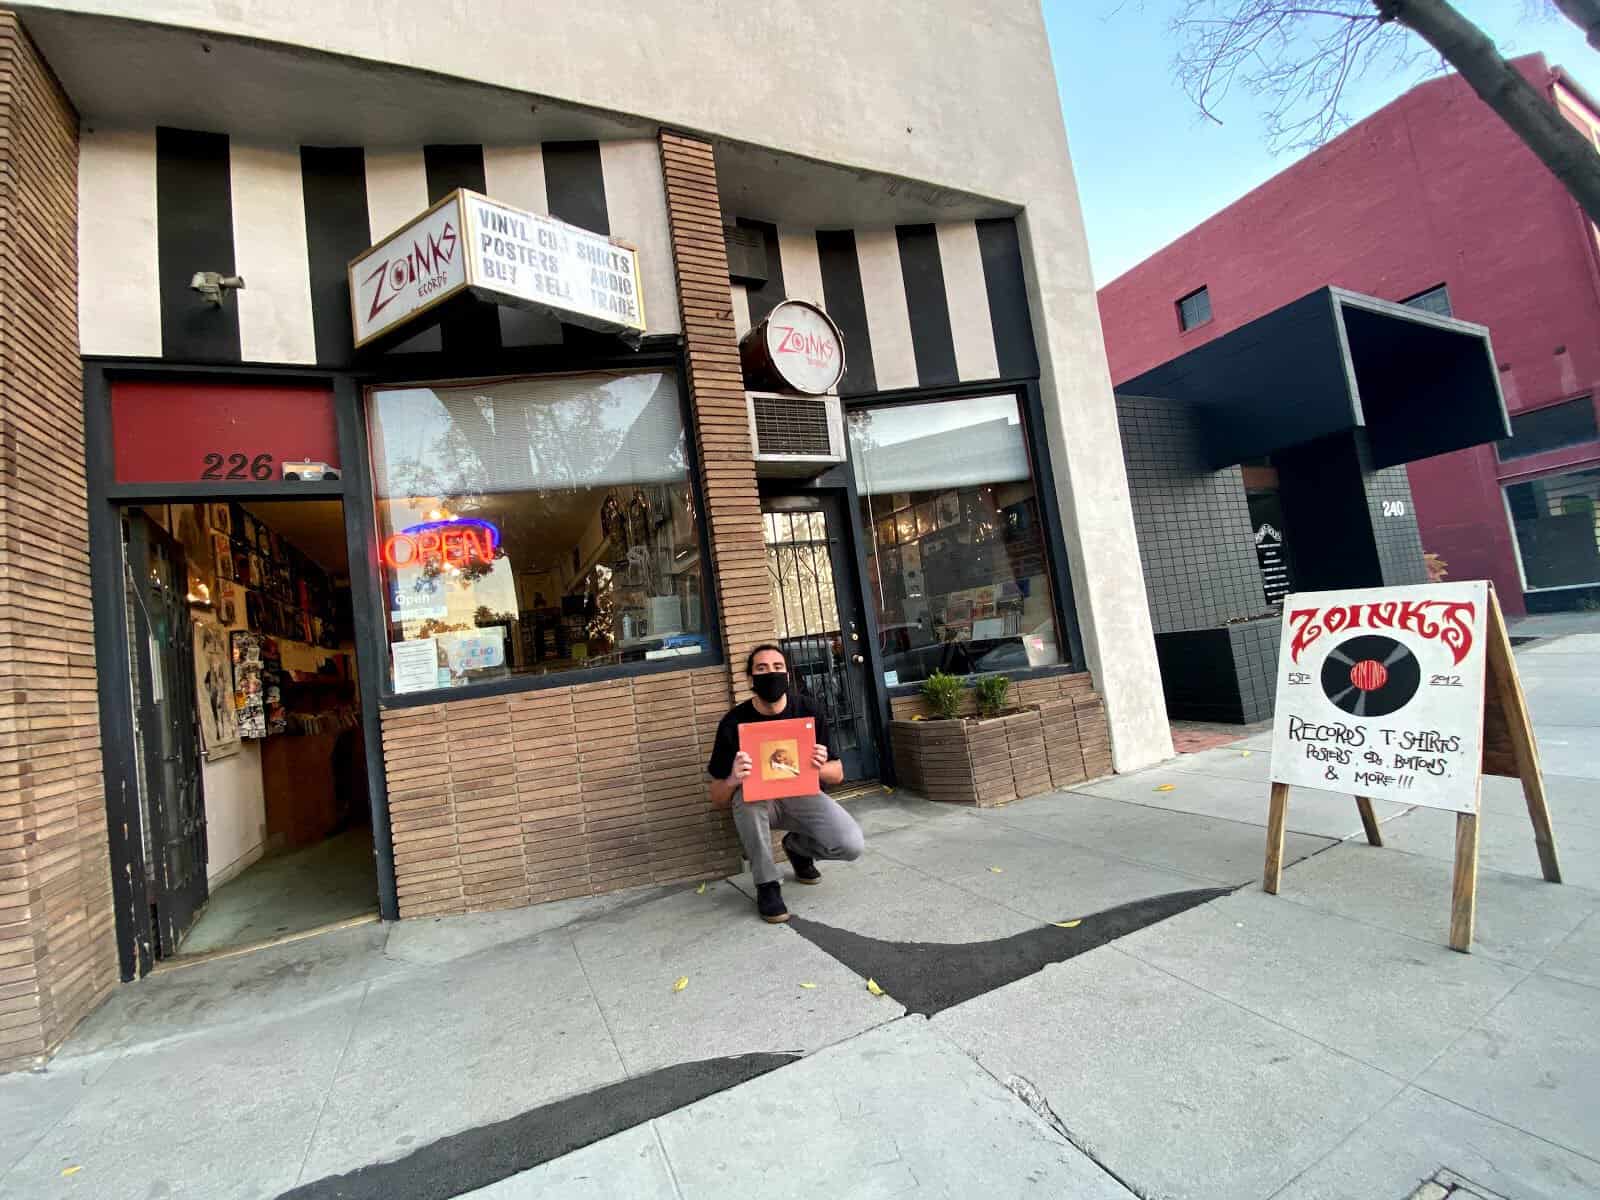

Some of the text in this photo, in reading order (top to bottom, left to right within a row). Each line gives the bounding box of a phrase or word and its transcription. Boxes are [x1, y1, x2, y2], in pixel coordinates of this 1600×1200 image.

[478, 207, 531, 243] VINYL
[576, 241, 630, 274] SHIRTS
[361, 221, 457, 322] ZOINKS
[480, 232, 560, 275] POSTERS
[590, 267, 633, 296] AUDIO
[773, 325, 834, 361] ZOINKS
[201, 452, 273, 480] 226
[1382, 500, 1405, 517] 240
[384, 528, 495, 569] OPEN
[1289, 599, 1476, 667] ZOINKS
[1325, 765, 1339, 780] &
